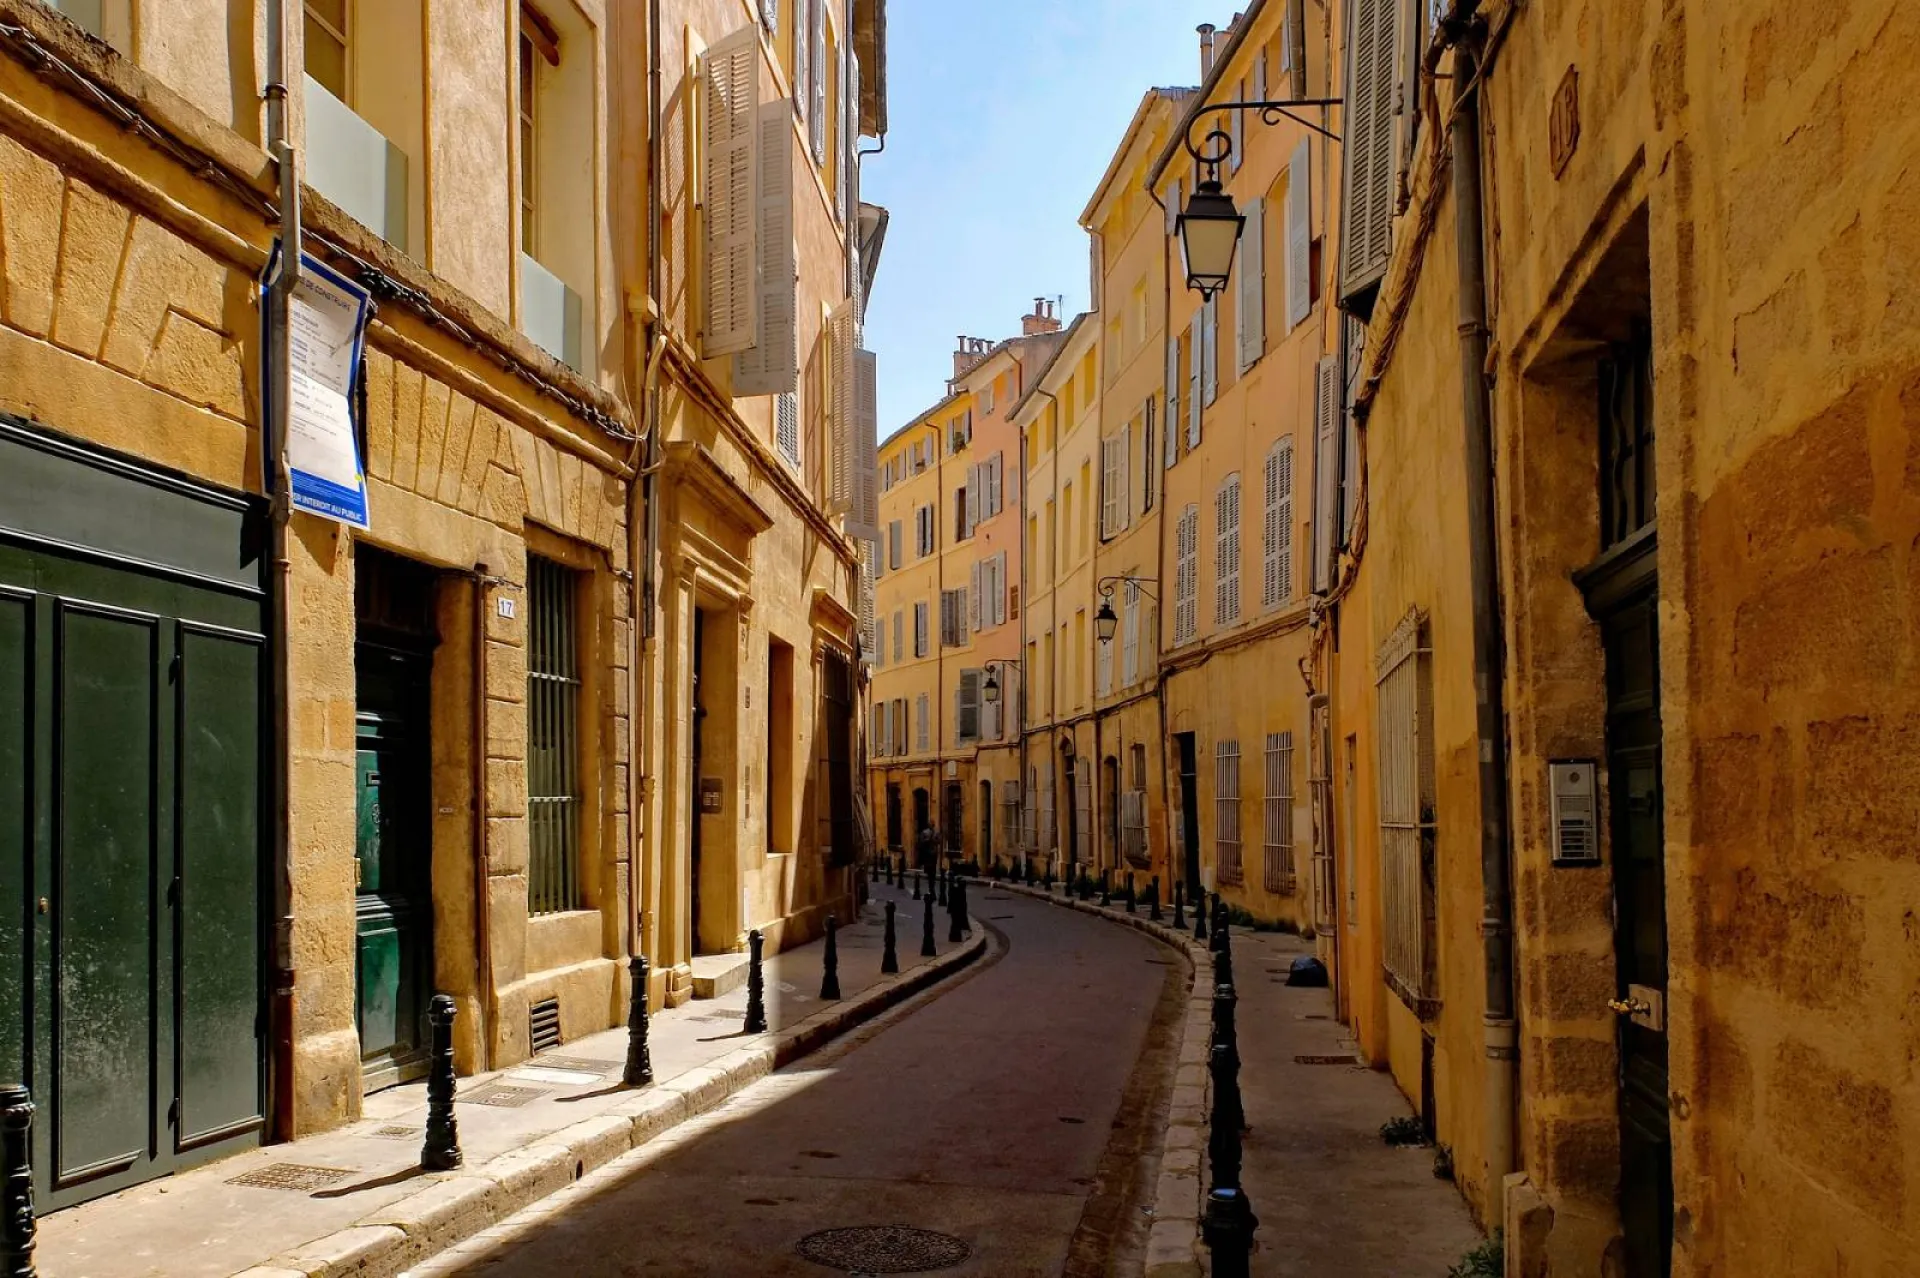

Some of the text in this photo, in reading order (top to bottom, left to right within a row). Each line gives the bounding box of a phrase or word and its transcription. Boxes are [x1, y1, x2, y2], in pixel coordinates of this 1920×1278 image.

[302, 495, 331, 510] INTERDIT
[331, 504, 342, 513] AU
[341, 508, 363, 522] PUBLIC
[501, 600, 512, 615] 17
